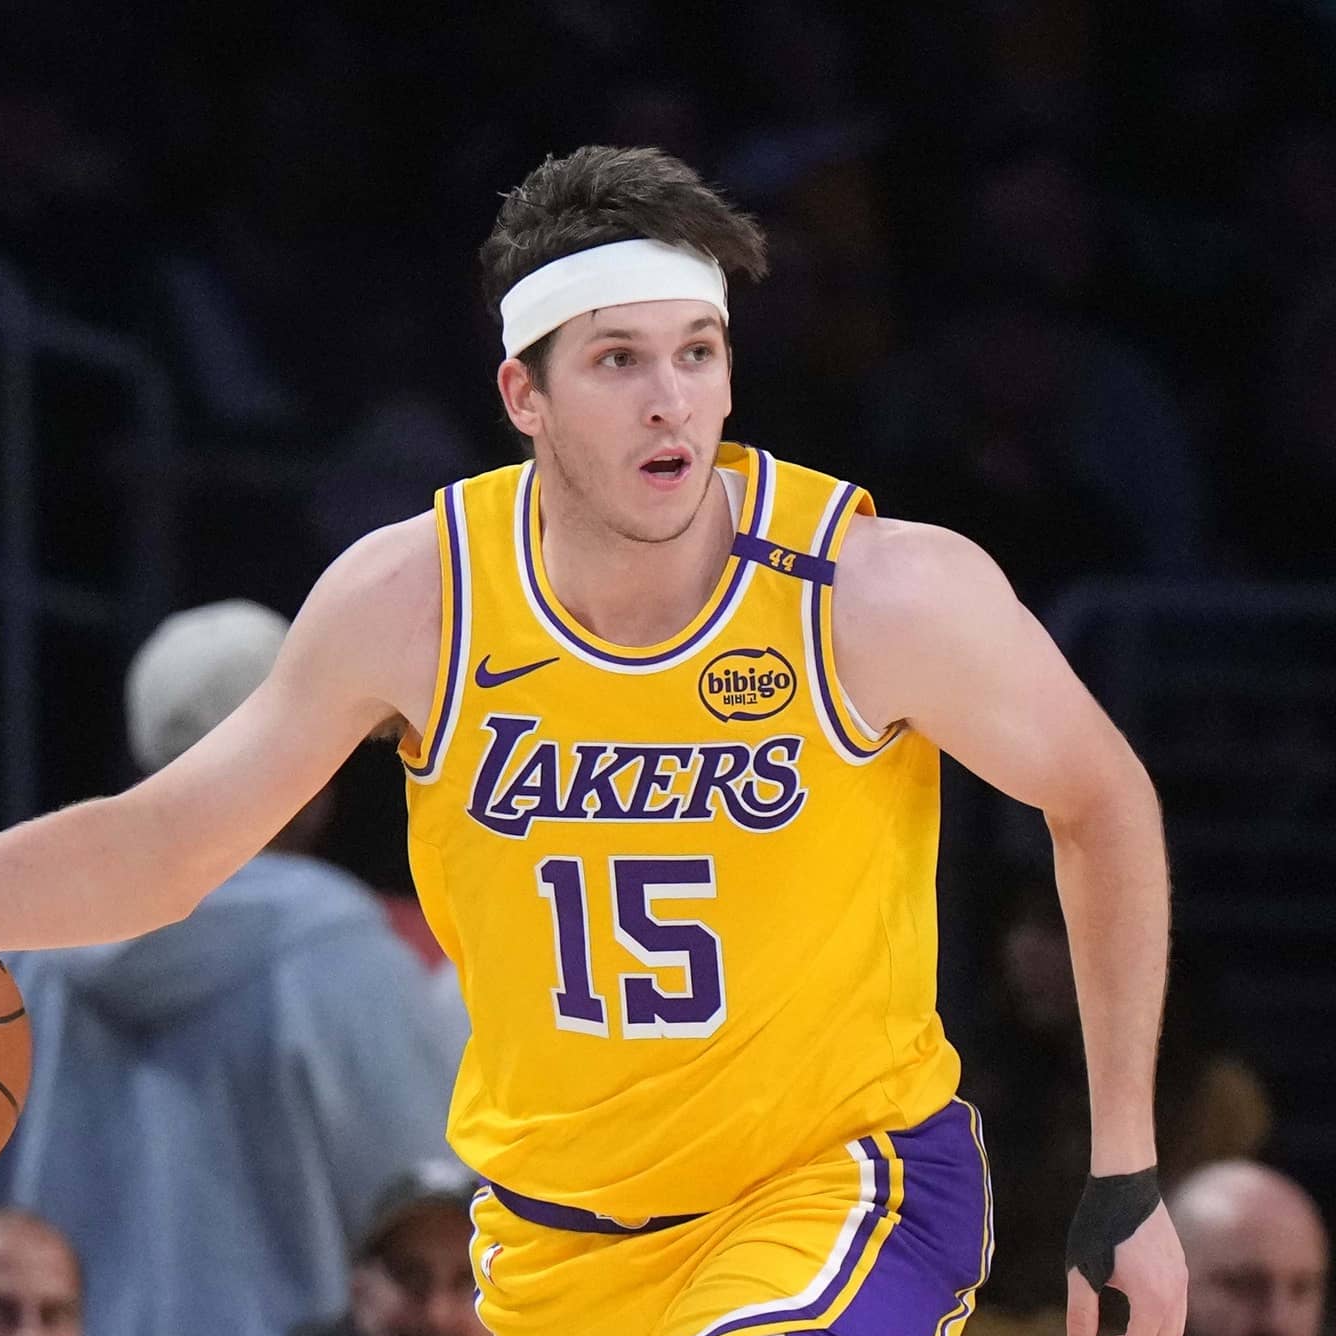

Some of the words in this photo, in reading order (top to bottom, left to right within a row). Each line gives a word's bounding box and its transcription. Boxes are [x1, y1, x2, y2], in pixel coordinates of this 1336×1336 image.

[768, 548, 797, 572] 44
[707, 667, 791, 699] bibigo
[722, 692, 758, 706] 비비고
[465, 713, 809, 840] LAKERS
[535, 855, 727, 1040] 15
